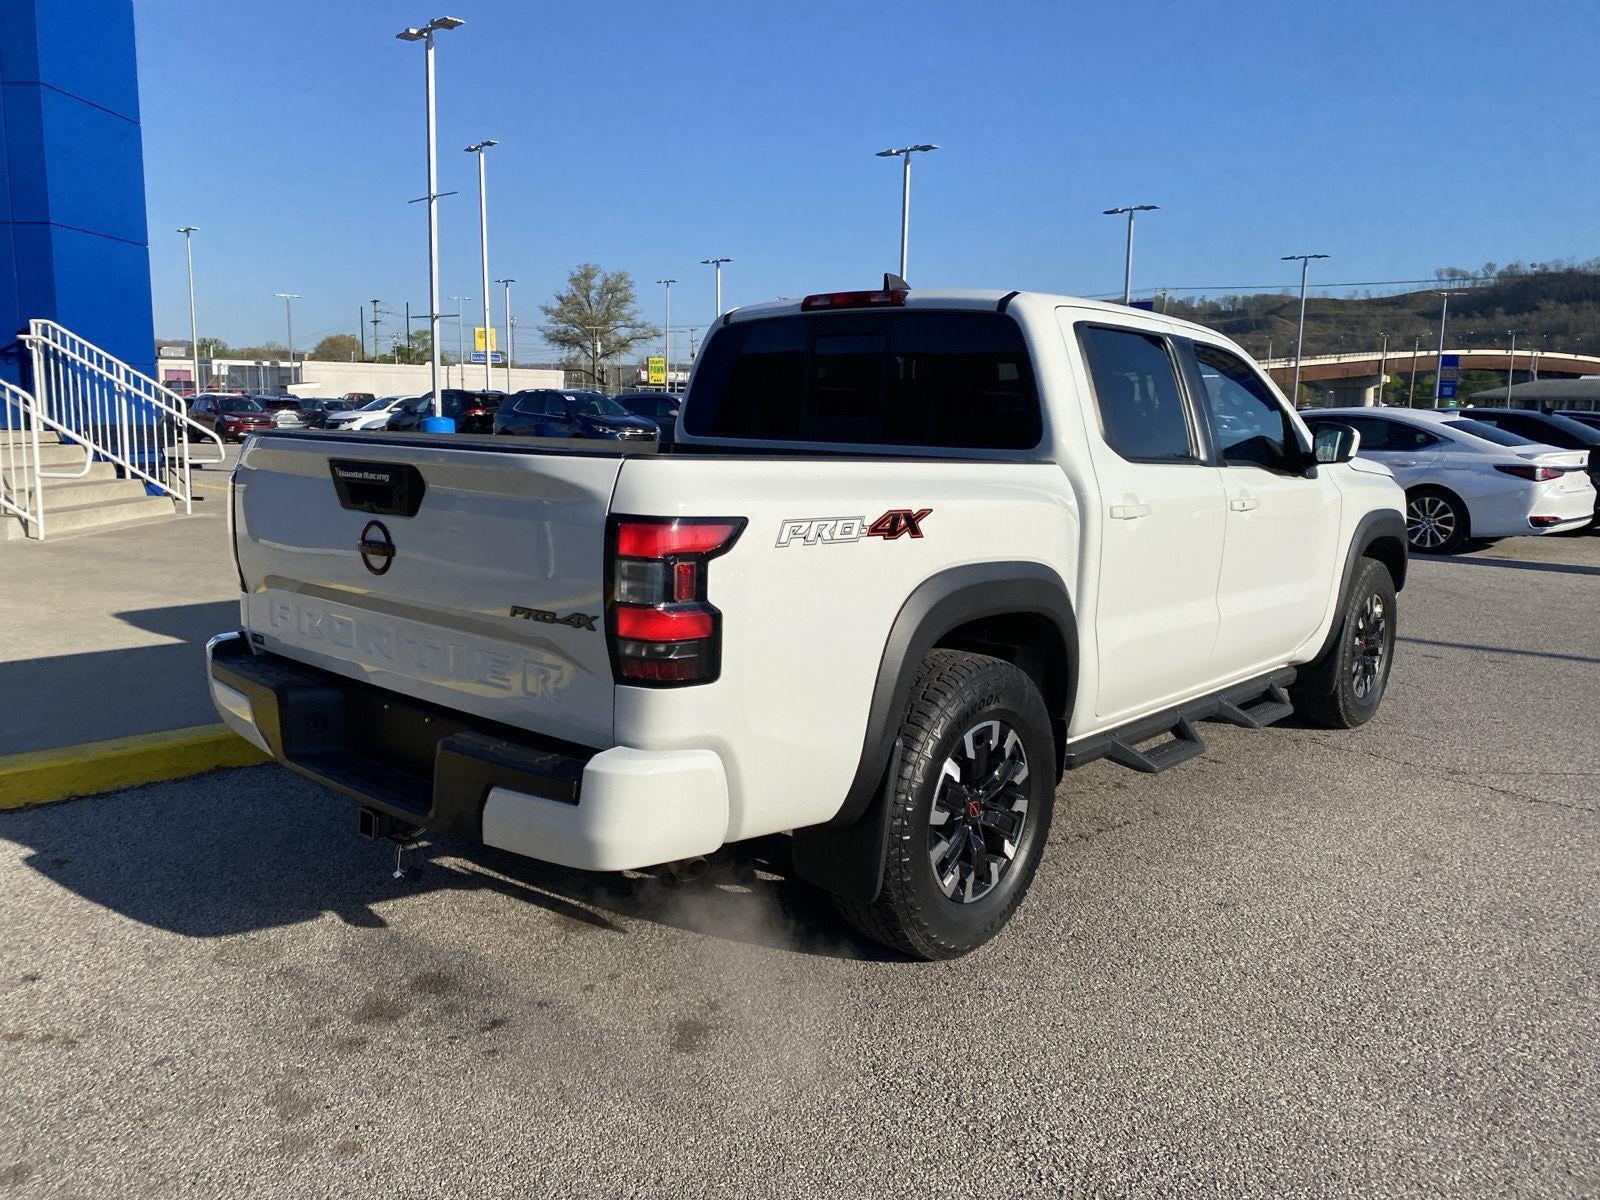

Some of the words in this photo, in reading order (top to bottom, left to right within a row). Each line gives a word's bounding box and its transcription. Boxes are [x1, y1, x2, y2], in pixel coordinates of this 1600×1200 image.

[339, 470, 362, 479] Honda
[363, 471, 390, 483] Racing
[774, 508, 934, 549] PRO-4X
[270, 598, 566, 703] FRONTIER
